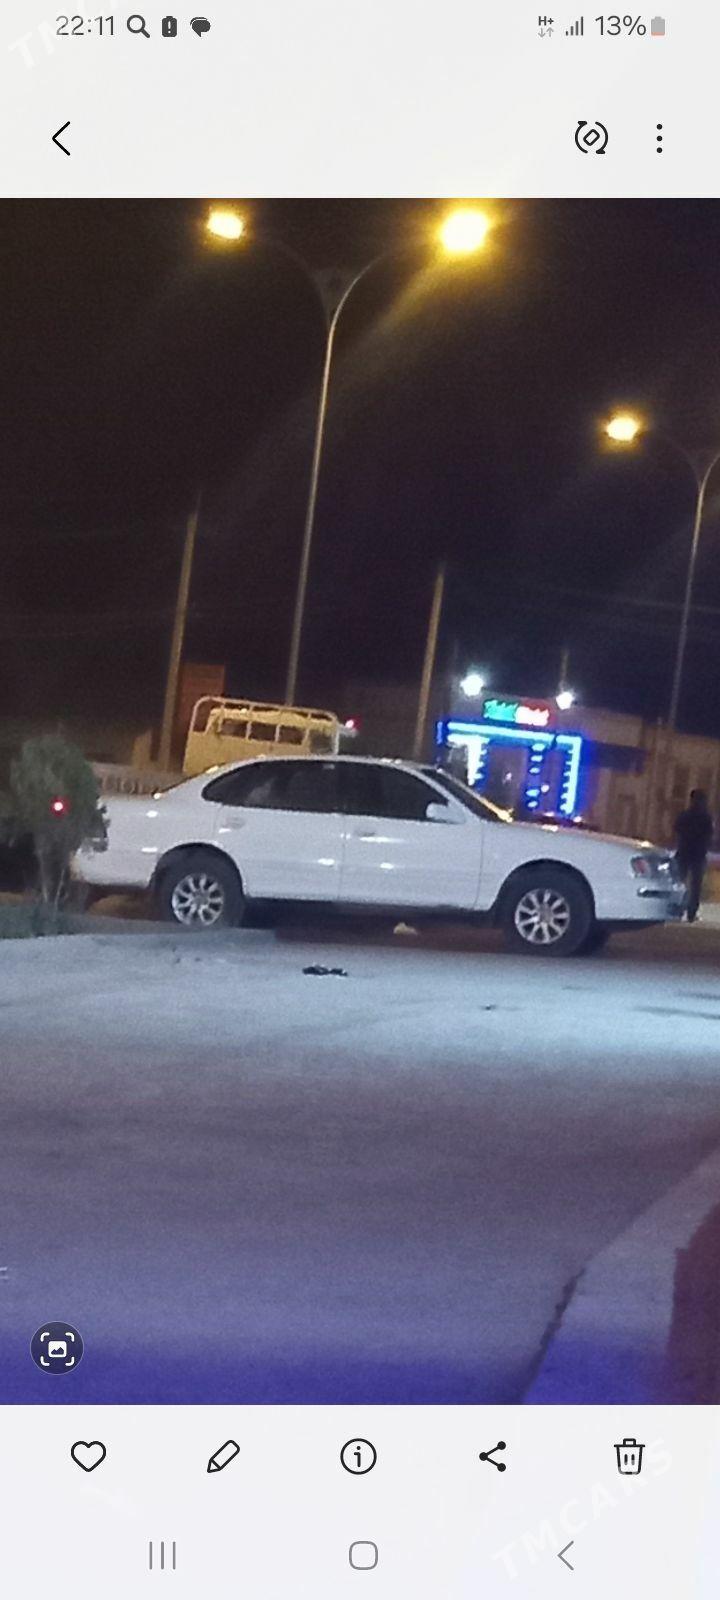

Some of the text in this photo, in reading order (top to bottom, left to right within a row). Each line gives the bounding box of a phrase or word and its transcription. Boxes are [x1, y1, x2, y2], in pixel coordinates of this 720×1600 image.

[55, 15, 115, 36] 22:11
[538, 16, 554, 26] H+
[595, 15, 647, 36] 13%
